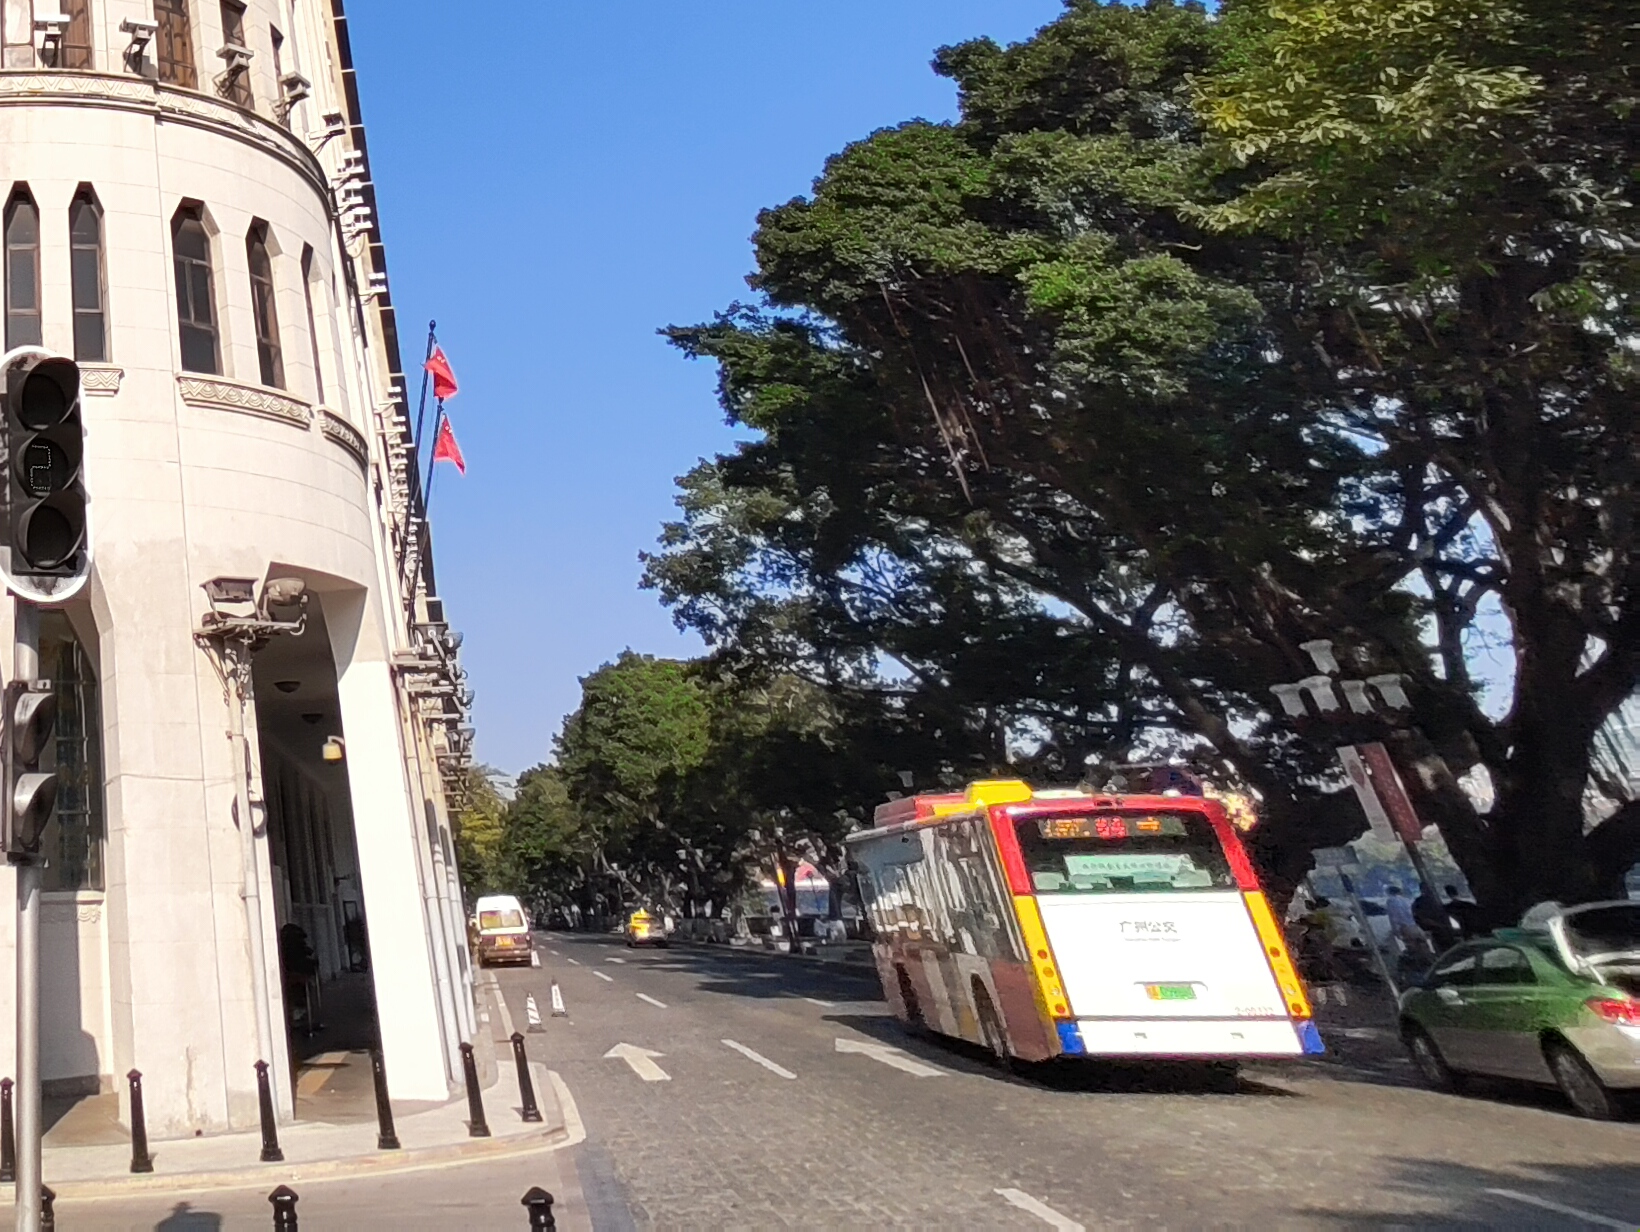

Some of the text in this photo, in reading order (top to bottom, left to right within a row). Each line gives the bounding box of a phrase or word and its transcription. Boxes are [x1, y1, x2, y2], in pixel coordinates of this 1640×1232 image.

[29, 443, 53, 491] 2
[1119, 920, 1178, 934] 广州公交
